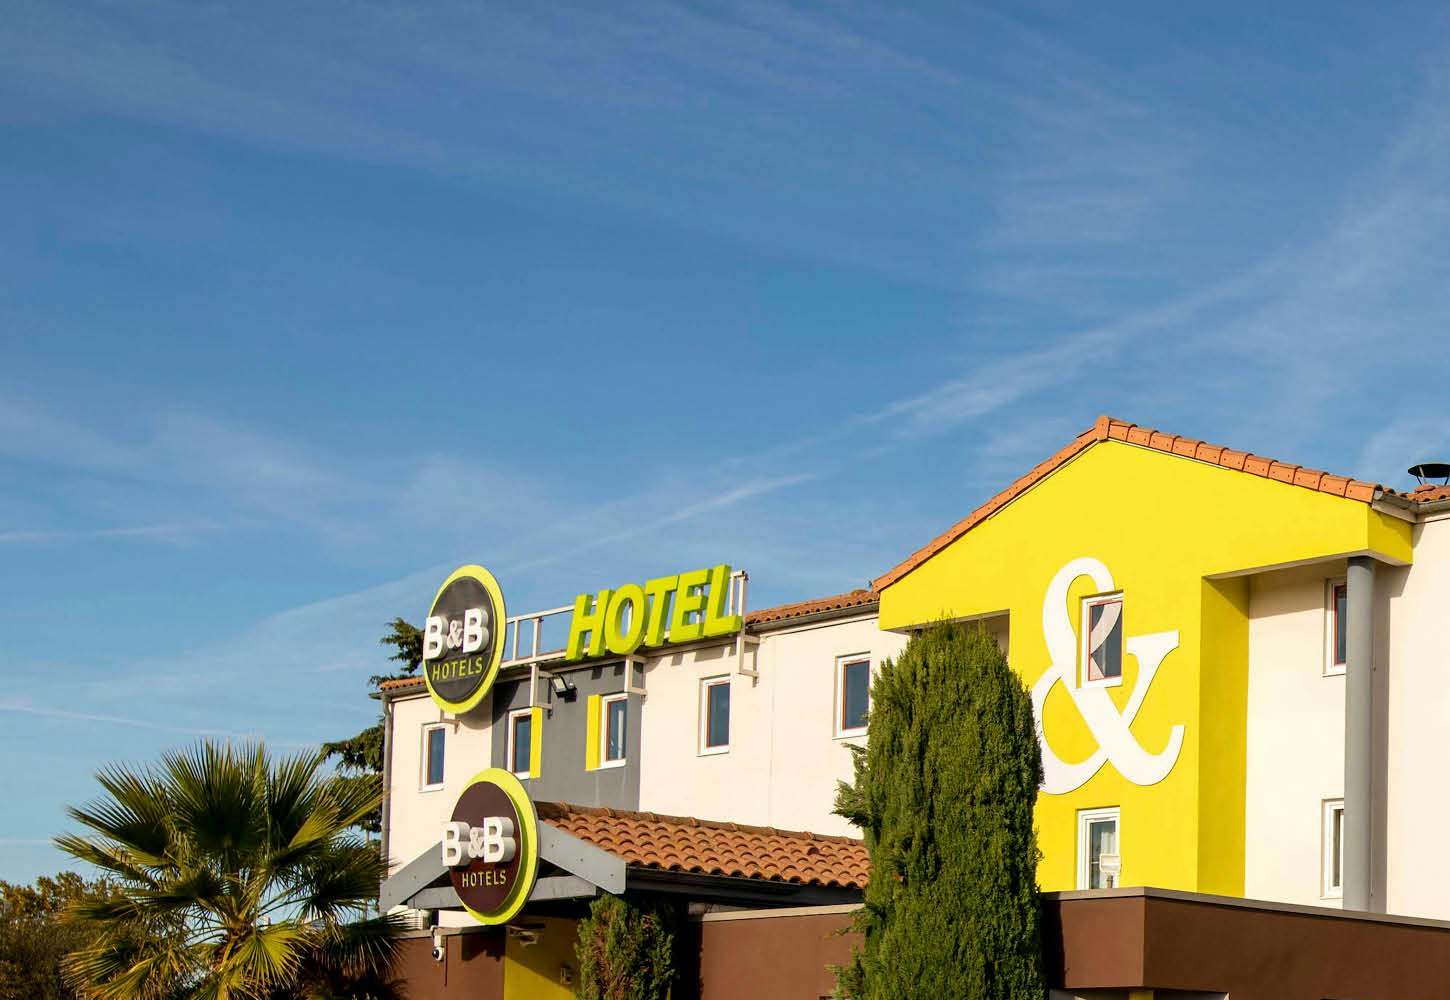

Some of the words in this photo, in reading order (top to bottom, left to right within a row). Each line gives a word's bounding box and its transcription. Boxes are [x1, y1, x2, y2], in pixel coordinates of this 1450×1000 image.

[423, 608, 490, 660] B&B
[565, 564, 742, 661] HOTEL
[432, 657, 483, 681] HOTELS
[1030, 557, 1185, 795] &
[441, 816, 517, 867] B&B
[462, 869, 507, 887] HOTELS
